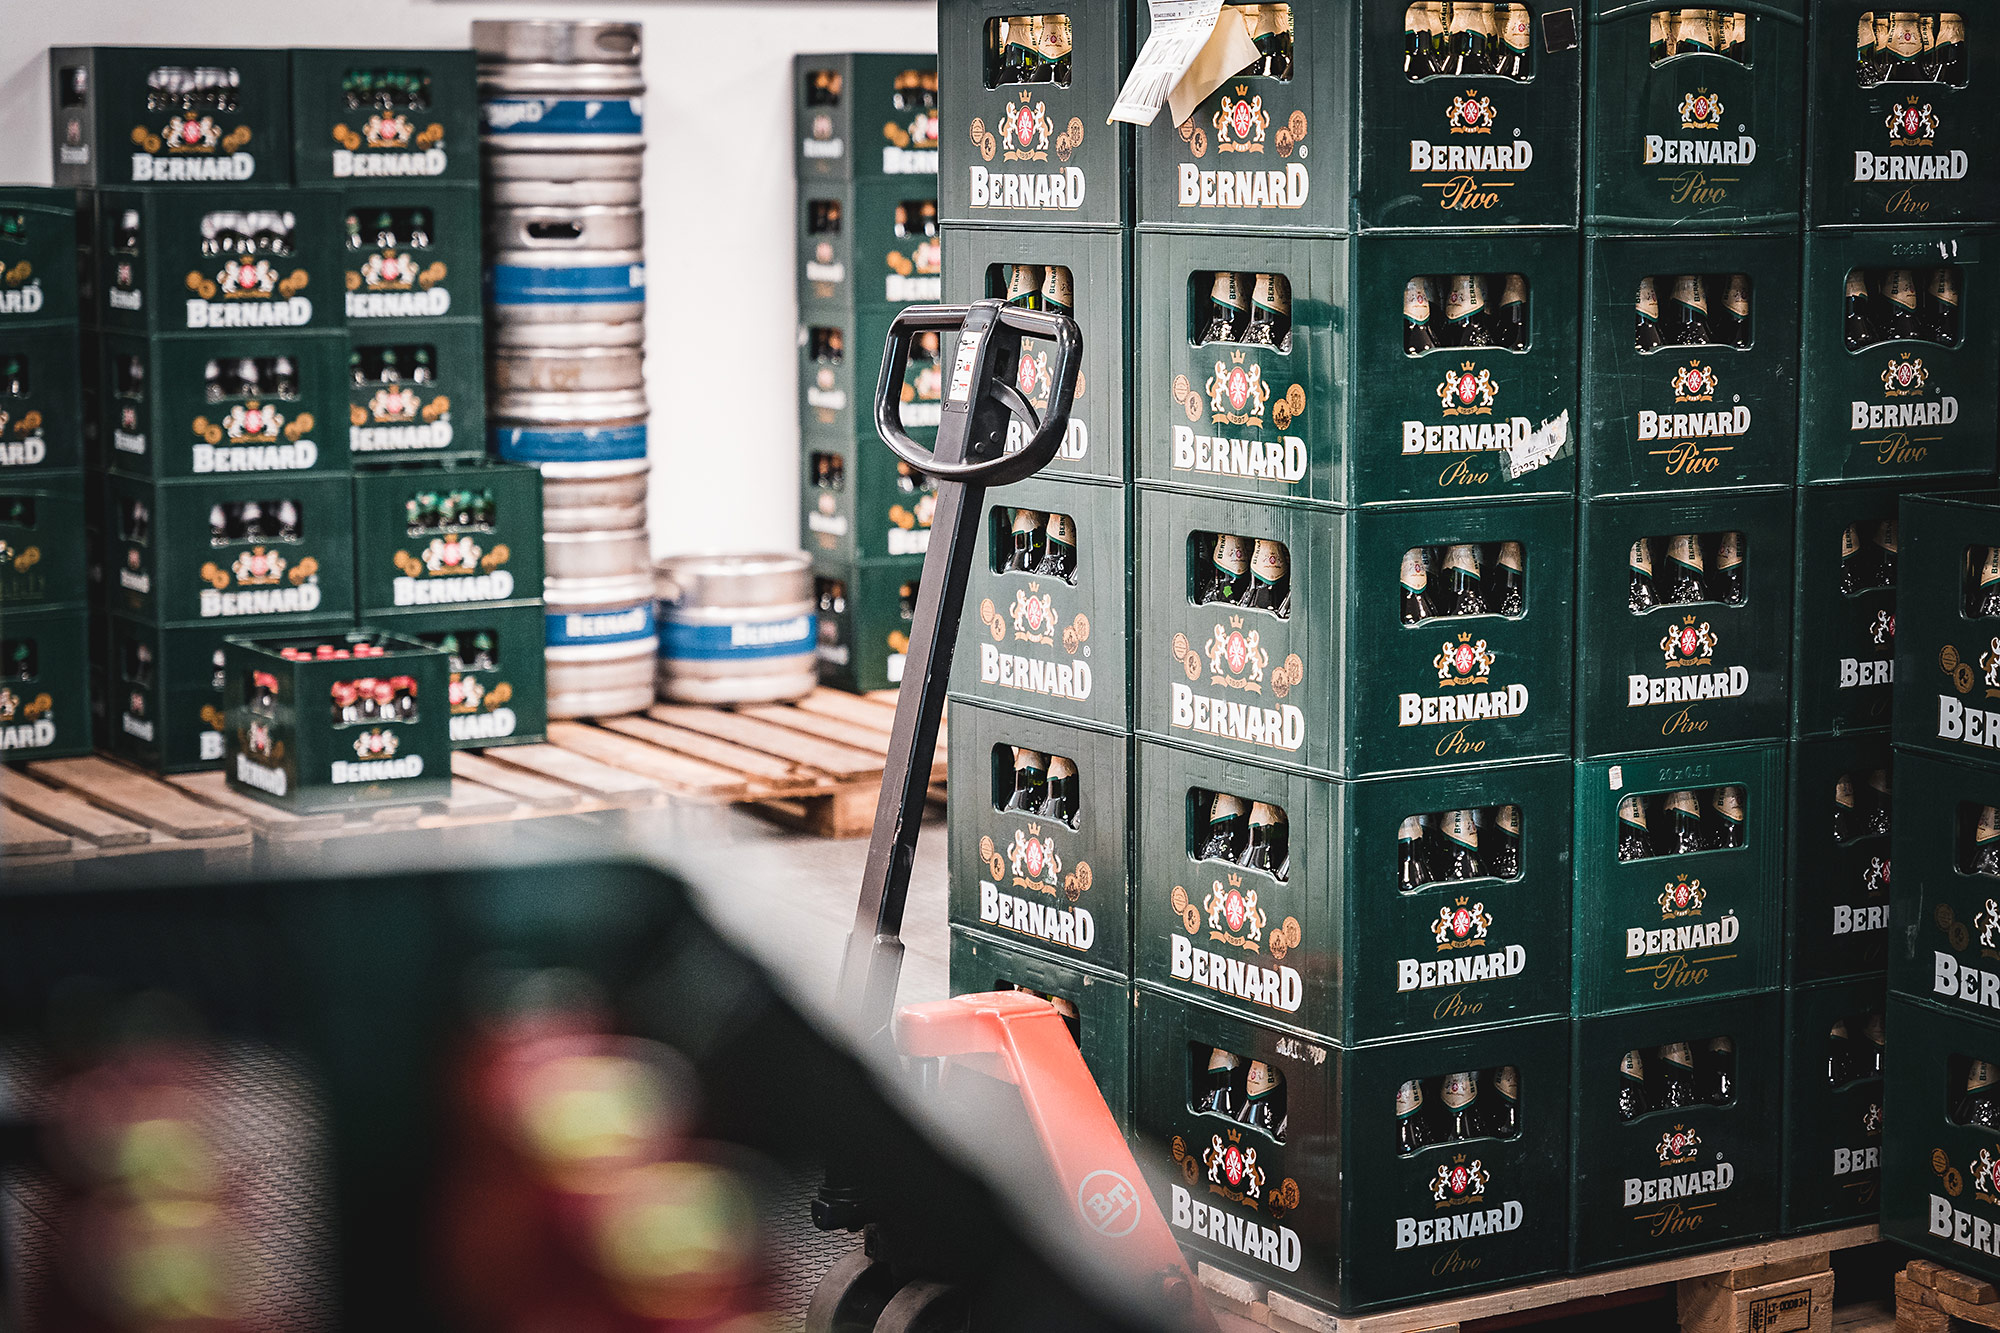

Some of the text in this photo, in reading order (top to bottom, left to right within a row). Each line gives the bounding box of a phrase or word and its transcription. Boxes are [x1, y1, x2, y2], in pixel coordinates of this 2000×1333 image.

[132, 153, 254, 181] BERNARD
[333, 147, 447, 176] BERNARD
[1410, 140, 1533, 171] BERNARD
[1643, 135, 1757, 166] BERNARD
[1853, 150, 1969, 182] BERNARD
[969, 166, 1085, 210] BERNARD
[1177, 163, 1309, 209] BERNARD
[1441, 174, 1500, 210] Pivo
[1670, 169, 1728, 205] Pivo
[1885, 184, 1931, 214] Pivo
[187, 297, 312, 327] BERNARD
[1637, 406, 1752, 441] BERNARD
[1850, 396, 1959, 431] BERNARD
[1401, 416, 1531, 455] BERNARD
[1877, 432, 1928, 465] Pivo
[192, 440, 317, 472] BERNARD
[1172, 425, 1308, 483] BERNARD
[1438, 455, 1489, 487] Pivo
[1665, 441, 1720, 476] Pivo
[980, 642, 1092, 700] BERNARD
[1627, 666, 1750, 708] BERNARD
[1171, 682, 1305, 750] BERNARD
[1399, 683, 1529, 727] BERNARD
[1661, 703, 1709, 736] Pivo
[1435, 724, 1486, 757] Pivo
[979, 880, 1095, 951] BERNARD
[1625, 914, 1740, 959] BERNARD
[1170, 933, 1303, 1012] BERNARD
[1397, 945, 1526, 993] BERNARD
[1652, 954, 1710, 991] Pivo
[1433, 987, 1484, 1021] Pivo
[1623, 1162, 1735, 1208] BERNARD
[1170, 1183, 1302, 1272] BERNARD
[1395, 1200, 1524, 1250] BERNARD
[1650, 1202, 1705, 1238] Pivo
[1431, 1245, 1482, 1278] Pivo
